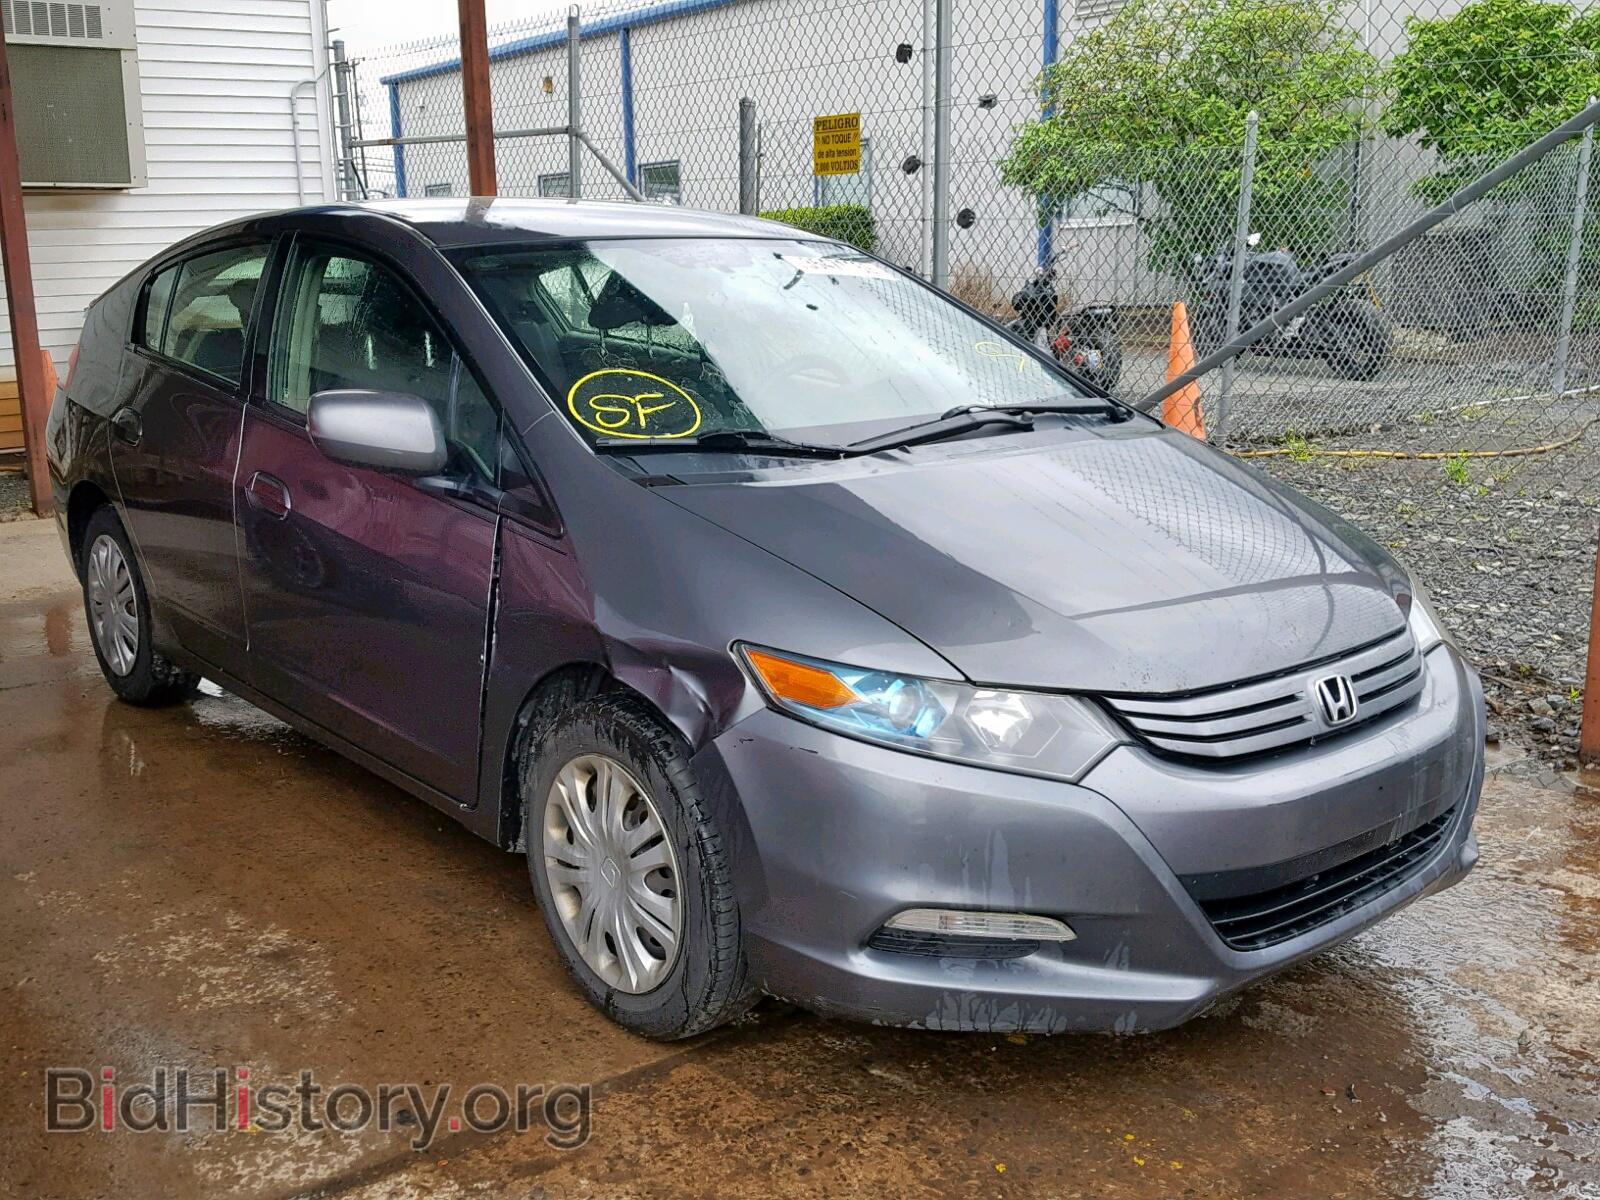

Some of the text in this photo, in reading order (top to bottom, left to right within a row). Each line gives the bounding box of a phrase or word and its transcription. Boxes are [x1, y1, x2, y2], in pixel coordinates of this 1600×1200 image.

[816, 117, 858, 131] PELIGRO
[822, 136, 830, 144] NO
[832, 133, 851, 144] TOQUE
[818, 150, 825, 159] de
[826, 149, 835, 158] alta
[831, 160, 858, 171] VOLTIOS
